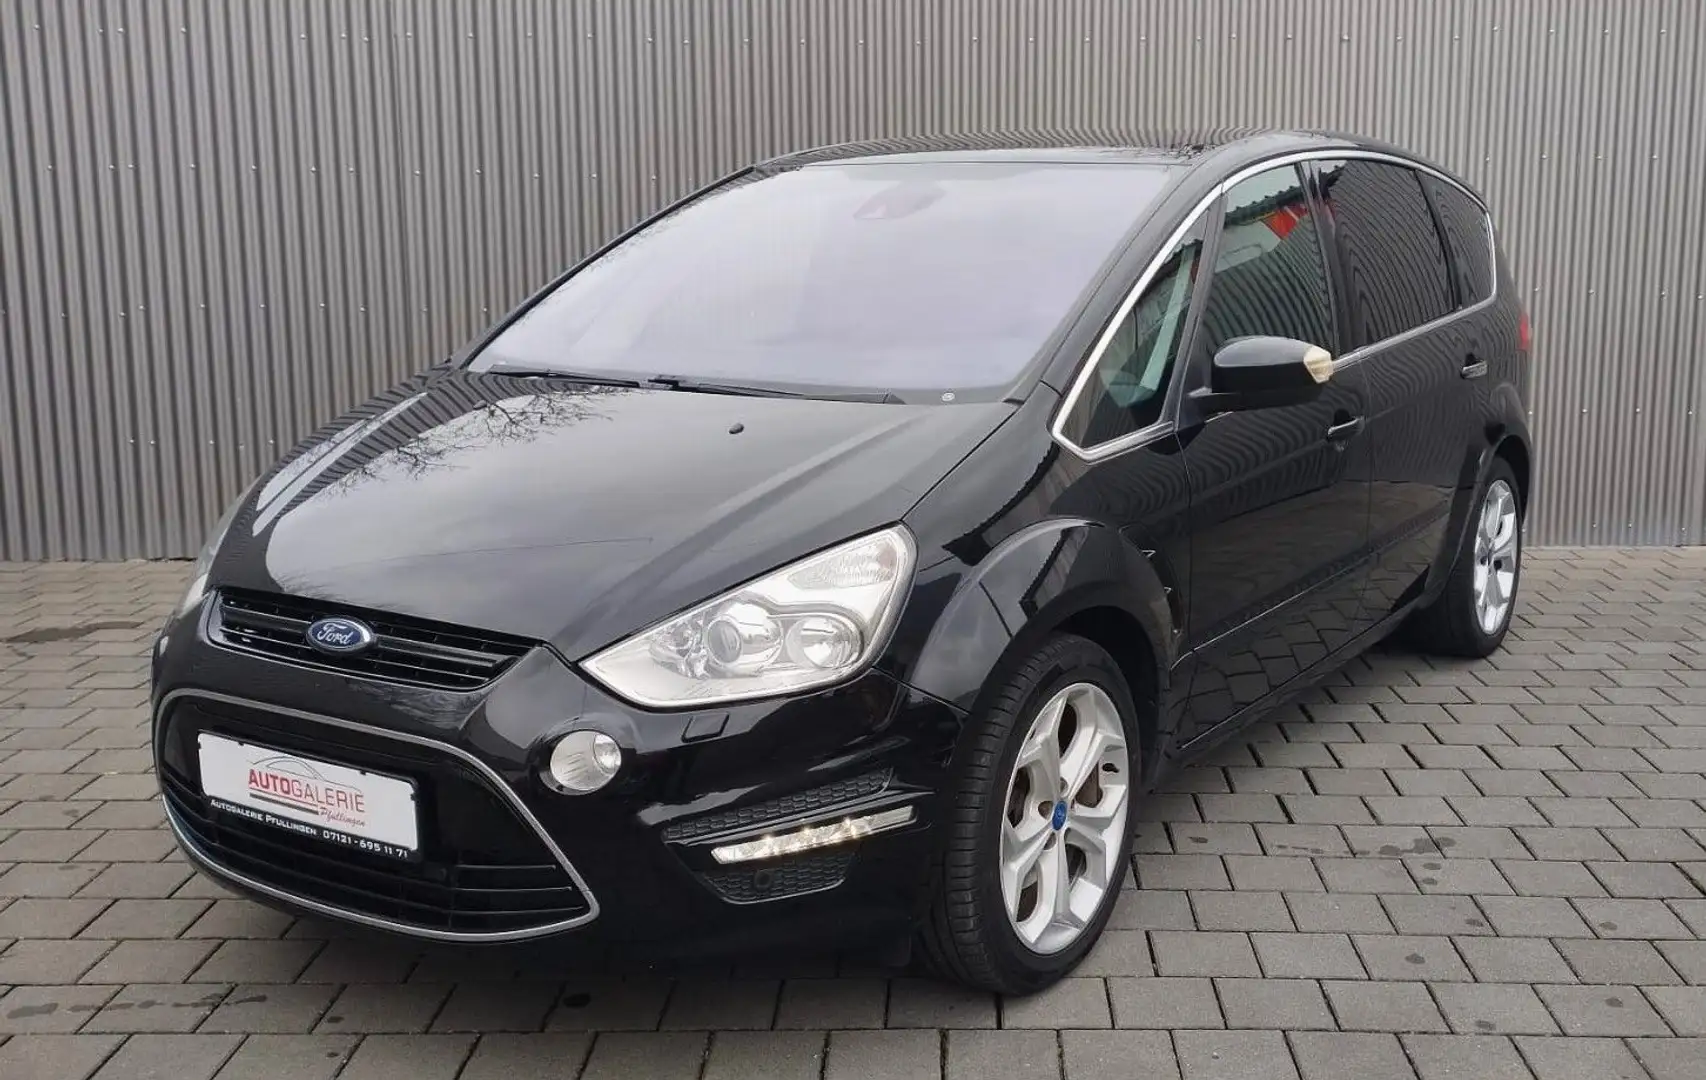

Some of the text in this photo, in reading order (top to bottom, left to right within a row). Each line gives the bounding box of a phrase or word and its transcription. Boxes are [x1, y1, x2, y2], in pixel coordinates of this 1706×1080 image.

[316, 622, 354, 645] Ford
[248, 768, 366, 813] AUTOGALERIE
[319, 806, 366, 827] Pfullingen
[323, 829, 351, 844] 07121
[359, 839, 381, 852] 695
[384, 846, 393, 855] 11
[396, 849, 408, 858] 71
